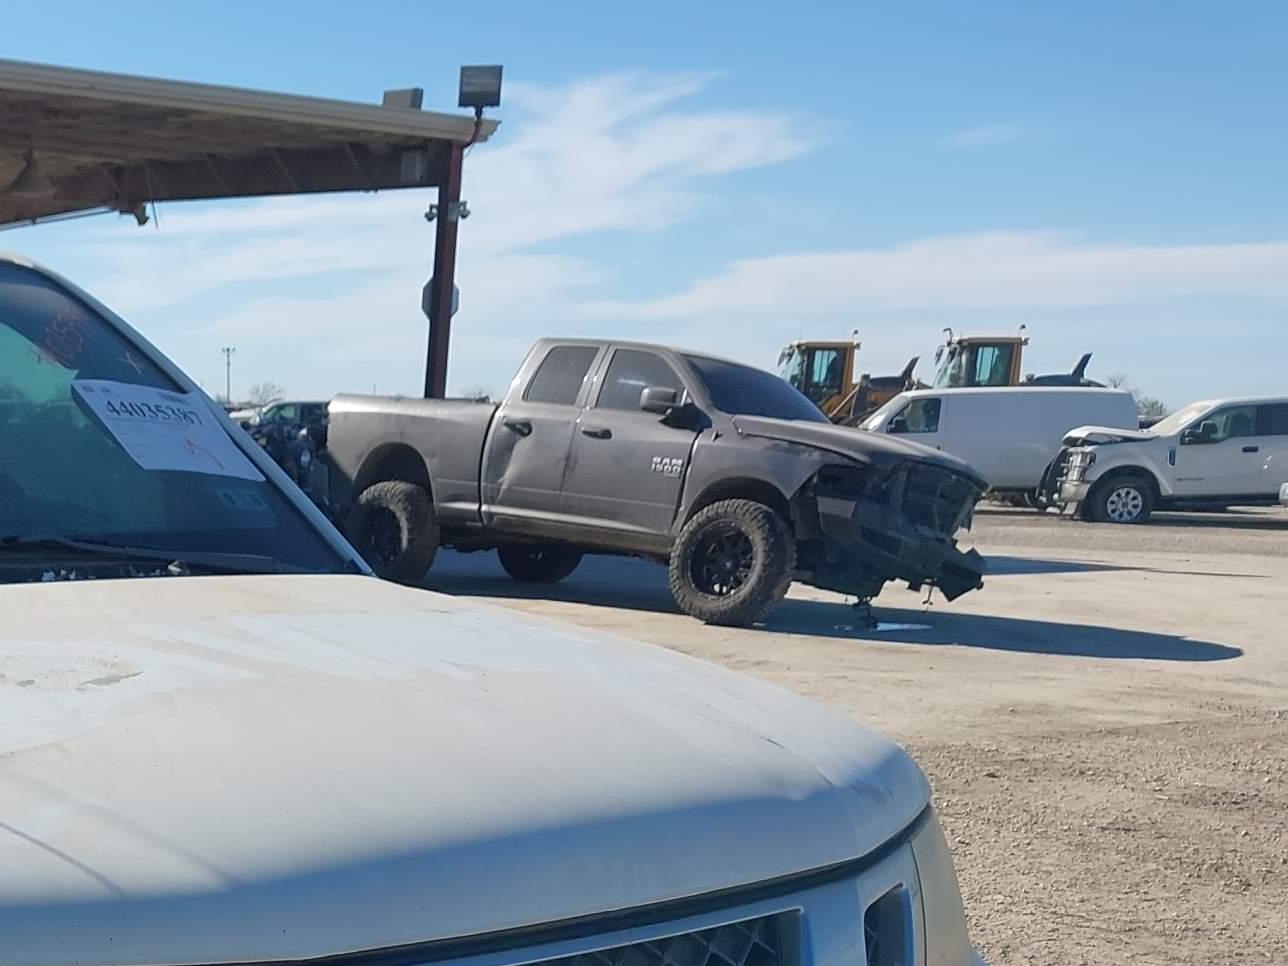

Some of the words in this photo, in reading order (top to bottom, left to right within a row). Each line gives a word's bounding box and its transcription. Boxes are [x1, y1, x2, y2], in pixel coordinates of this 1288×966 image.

[106, 400, 204, 426] 44035387
[652, 456, 683, 465] RAM
[651, 463, 682, 474] 1500
